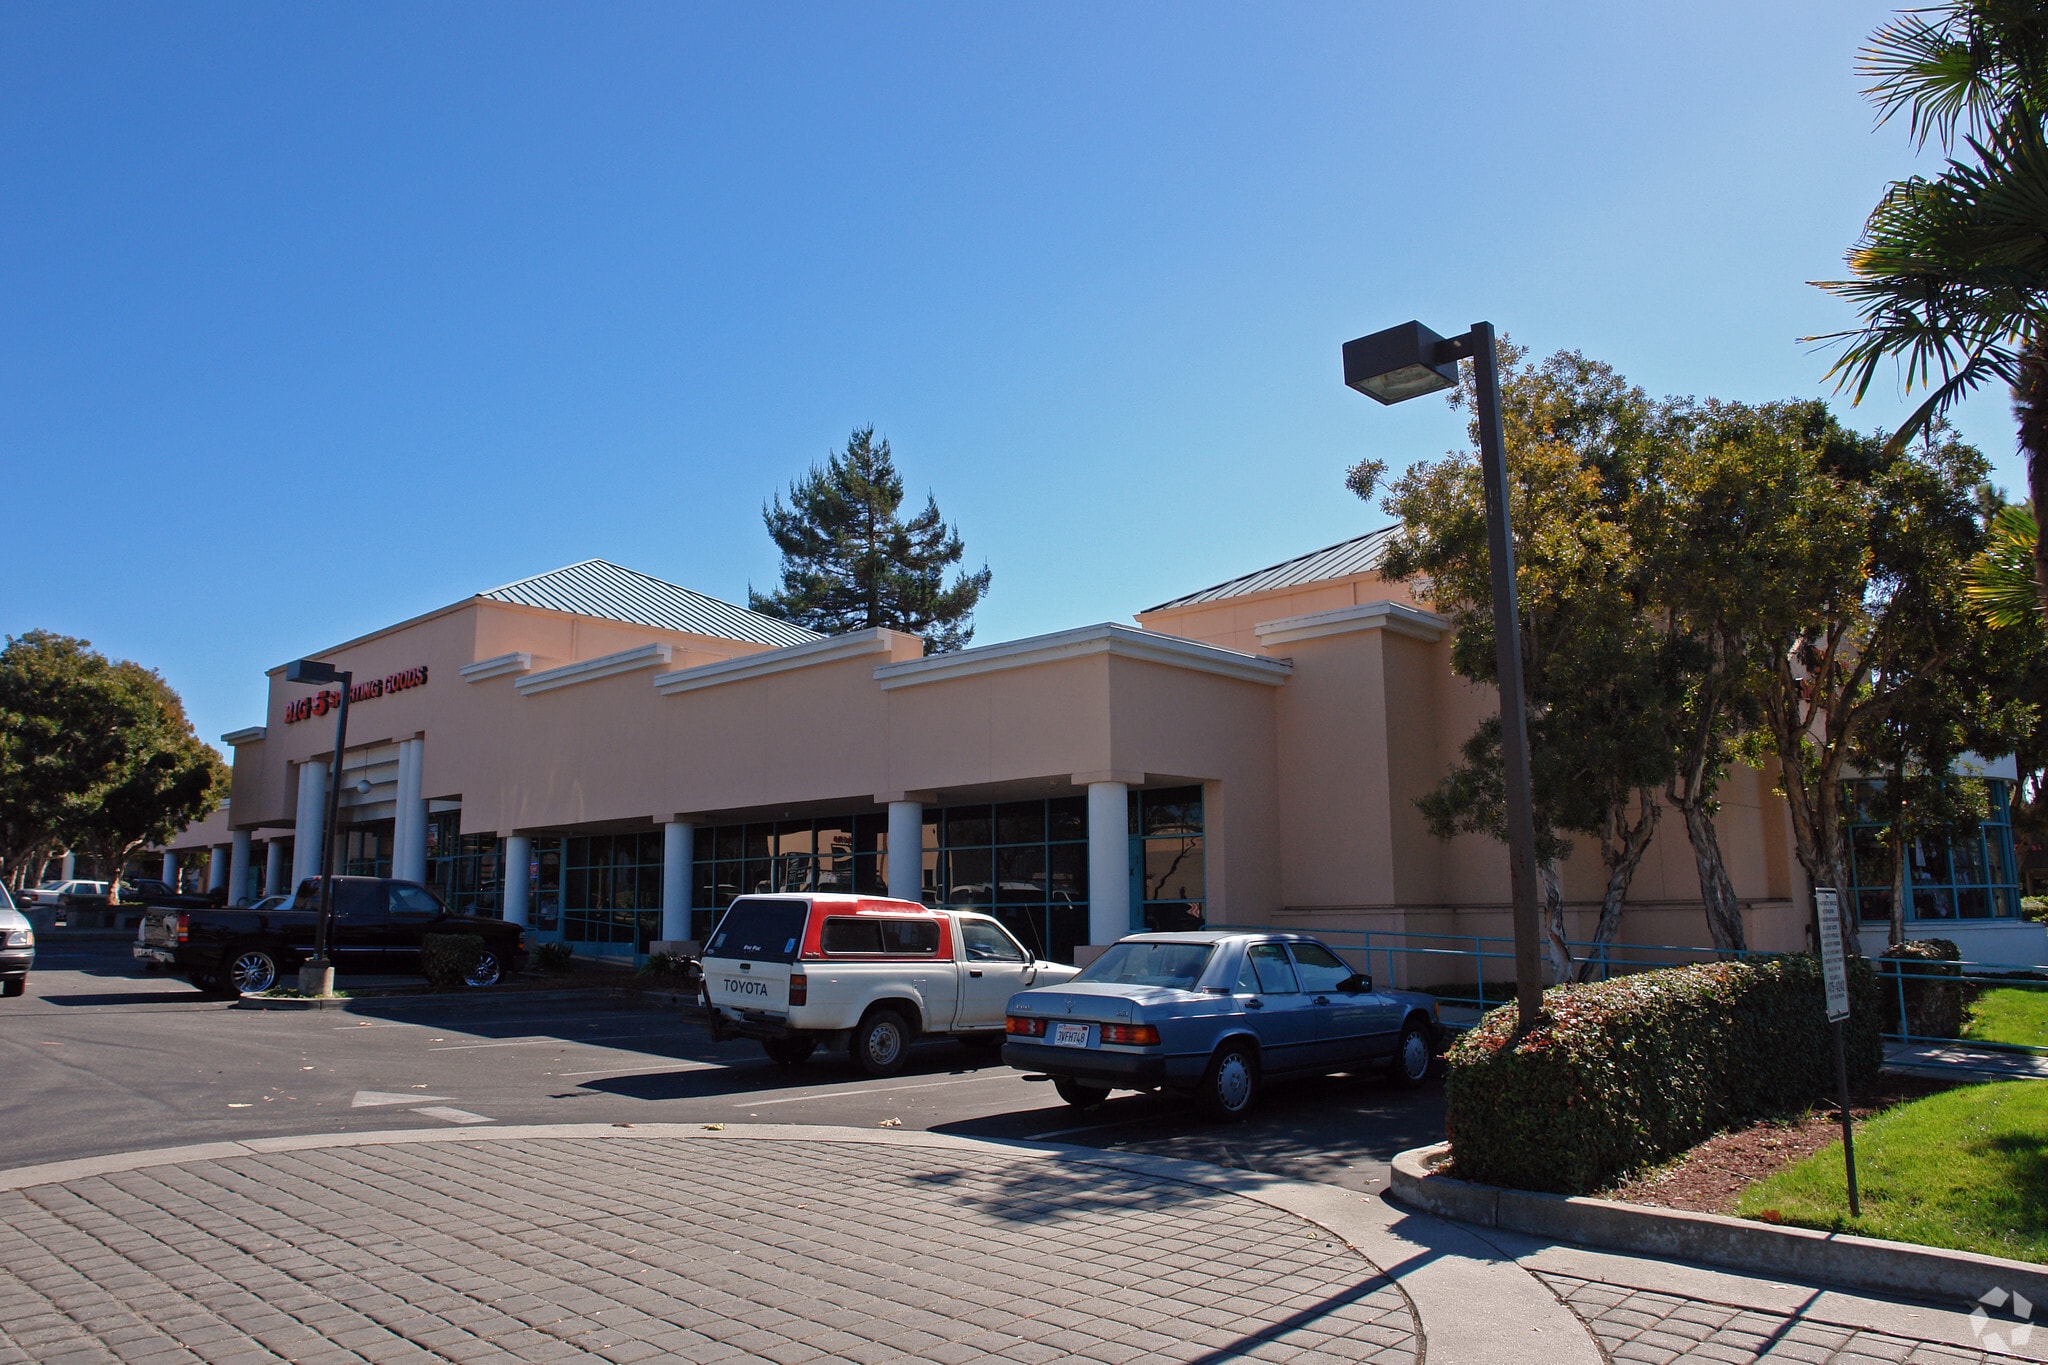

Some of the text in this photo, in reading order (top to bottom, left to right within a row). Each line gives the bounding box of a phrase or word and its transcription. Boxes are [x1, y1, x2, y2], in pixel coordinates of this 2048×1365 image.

[284, 666, 428, 724] BIG 5 SPRTING GOODS
[724, 978, 768, 996] TOYOTA
[1056, 1030, 1086, 1043] 3VFH748
